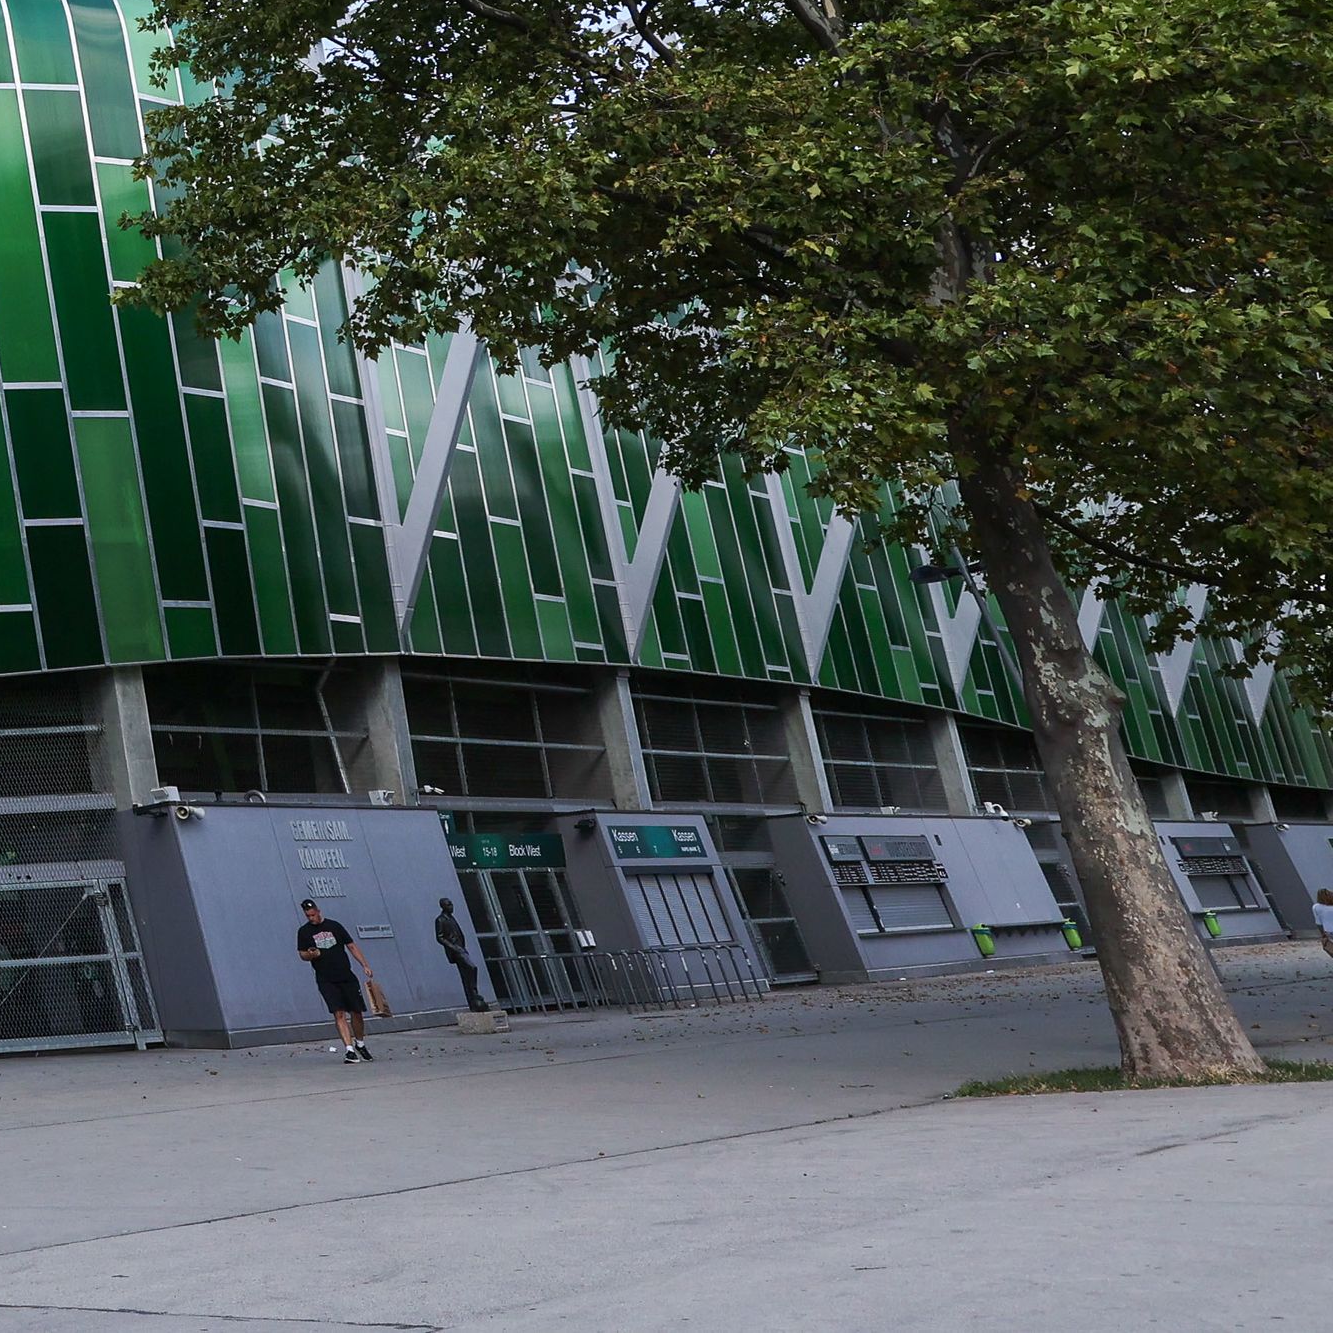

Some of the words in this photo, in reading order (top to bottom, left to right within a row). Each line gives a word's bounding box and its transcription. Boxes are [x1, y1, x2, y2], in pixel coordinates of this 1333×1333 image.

[290, 820, 353, 841] GEMEINSAM.
[612, 829, 639, 842] Kassen
[671, 829, 697, 842] Kassen
[297, 846, 349, 870] KÄMPFEN.
